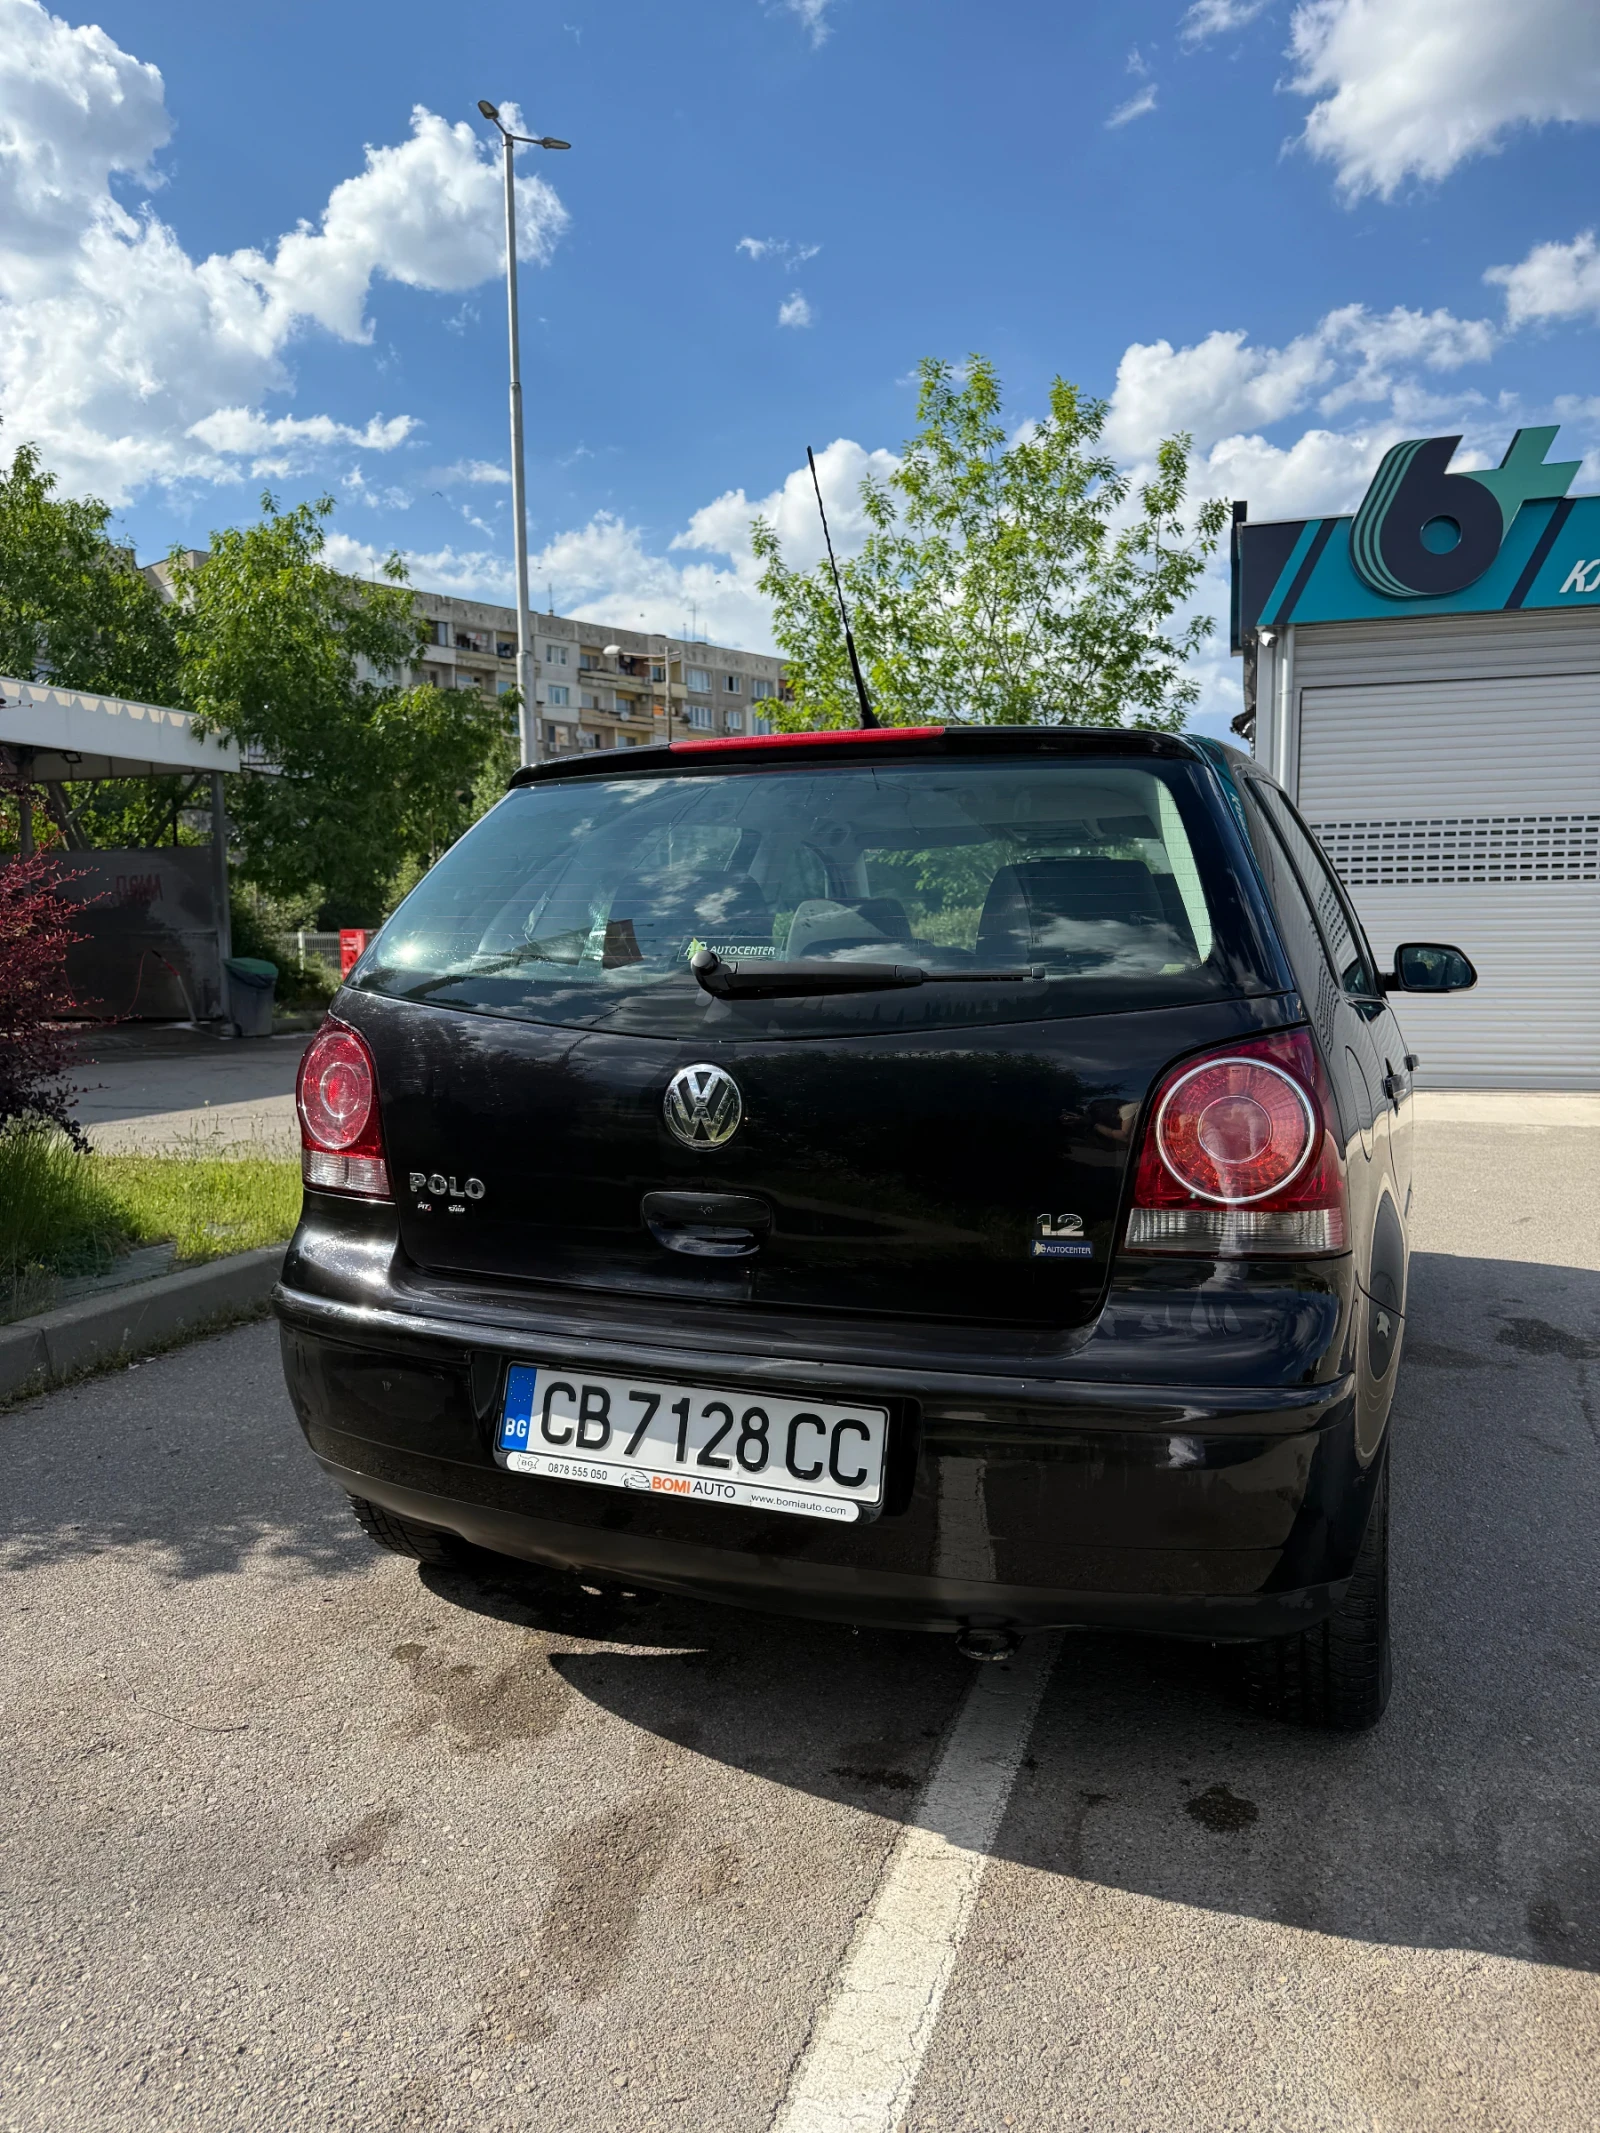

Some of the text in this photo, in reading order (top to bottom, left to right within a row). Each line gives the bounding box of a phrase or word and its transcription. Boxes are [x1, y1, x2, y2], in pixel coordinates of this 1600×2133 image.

[709, 945, 776, 956] AUTOCENTER
[665, 1065, 741, 1148] VW
[409, 1172, 486, 1200] POLO
[1046, 1245, 1091, 1255] AUTOCENTER
[505, 1417, 527, 1438] BG
[540, 1381, 871, 1488] CB 7128 CC
[521, 1459, 534, 1468] BG
[547, 1462, 608, 1481] 0878 555 050
[651, 1476, 737, 1499] BOMI AUTO
[750, 1493, 847, 1516] www.bomiauto.com
